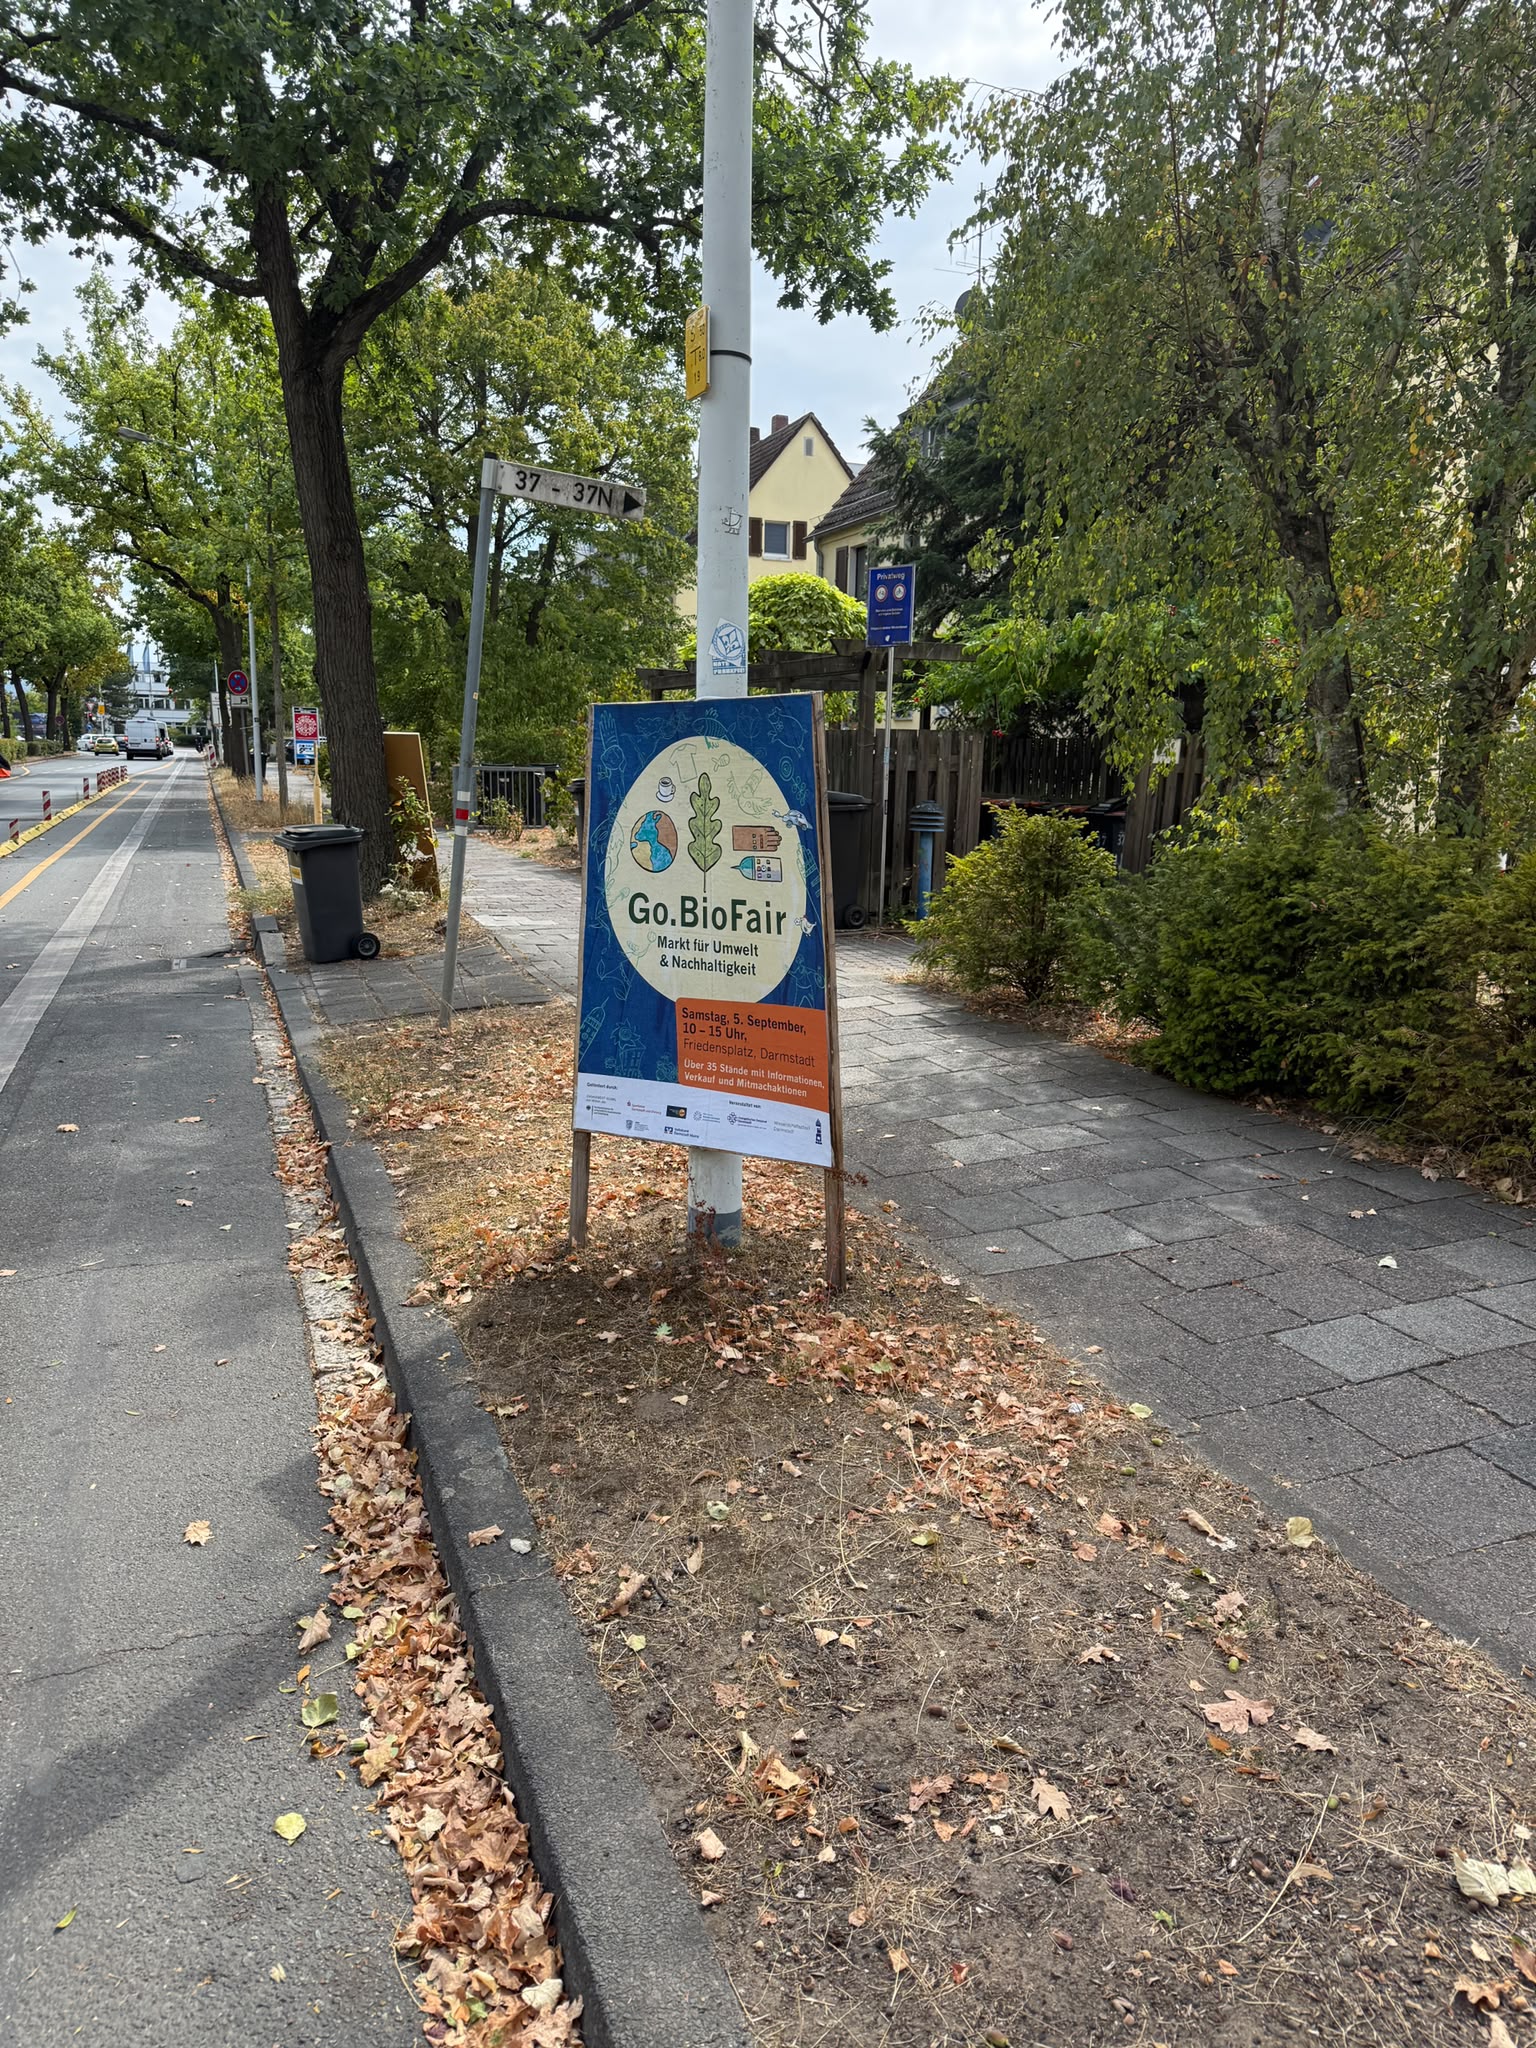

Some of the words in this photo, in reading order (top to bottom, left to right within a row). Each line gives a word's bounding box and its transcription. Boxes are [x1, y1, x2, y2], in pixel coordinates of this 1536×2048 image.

[515, 470, 541, 493] 37
[573, 482, 613, 509] 37N
[877, 572, 905, 581] Privatweg
[628, 892, 787, 935] Go.BioFair
[657, 935, 690, 951] Markt
[693, 938, 710, 953] für
[713, 940, 759, 957] Umwelt
[659, 954, 669, 968] &
[672, 955, 757, 977] Nachhaltigkeit
[682, 1007, 730, 1026] Samstag,
[733, 1013, 744, 1025] 5.
[747, 1014, 807, 1036] September,
[683, 1022, 697, 1035] 10
[708, 1025, 722, 1038] 15
[725, 1027, 748, 1043] Uhr,
[683, 1038, 757, 1060] Friedensplatz,
[760, 1047, 816, 1068] Darmstadt
[684, 1058, 705, 1071] Über
[706, 1061, 718, 1072] 35
[720, 1063, 749, 1076] Stände
[751, 1068, 765, 1079] mit
[767, 1070, 825, 1089] Informationen,
[684, 1071, 716, 1084] Verkauf
[718, 1077, 734, 1087] und
[736, 1078, 808, 1098] Mitmachaktionen
